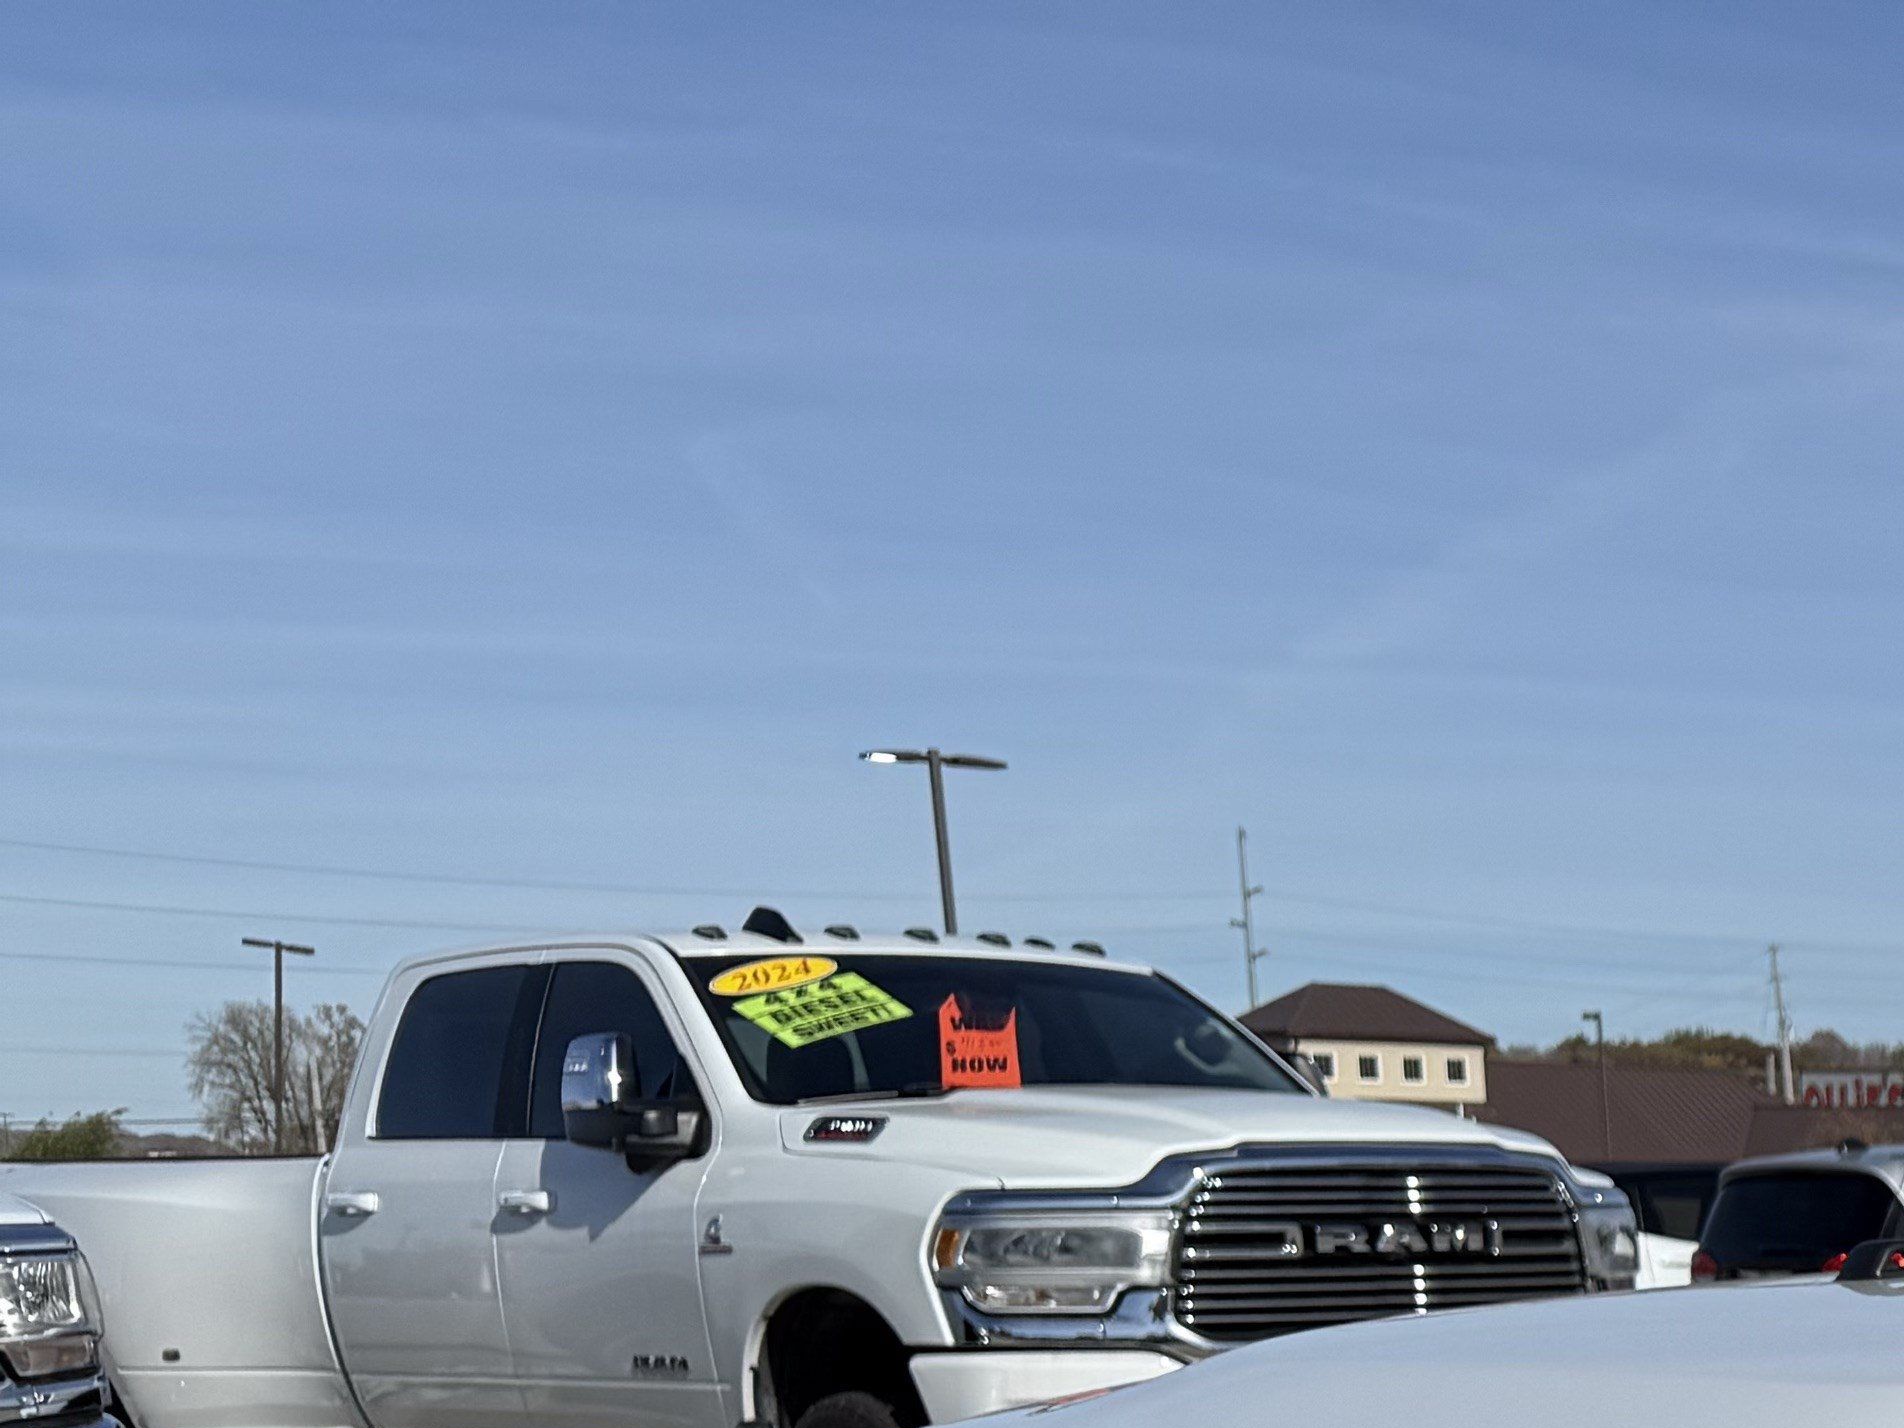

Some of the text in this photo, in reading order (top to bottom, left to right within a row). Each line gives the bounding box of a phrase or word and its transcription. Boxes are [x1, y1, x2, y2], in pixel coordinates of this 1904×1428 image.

[731, 957, 812, 991] 2024
[771, 990, 879, 1025] DIESEL
[950, 1056, 1008, 1073] NOW
[1314, 1222, 1487, 1255] RAM
